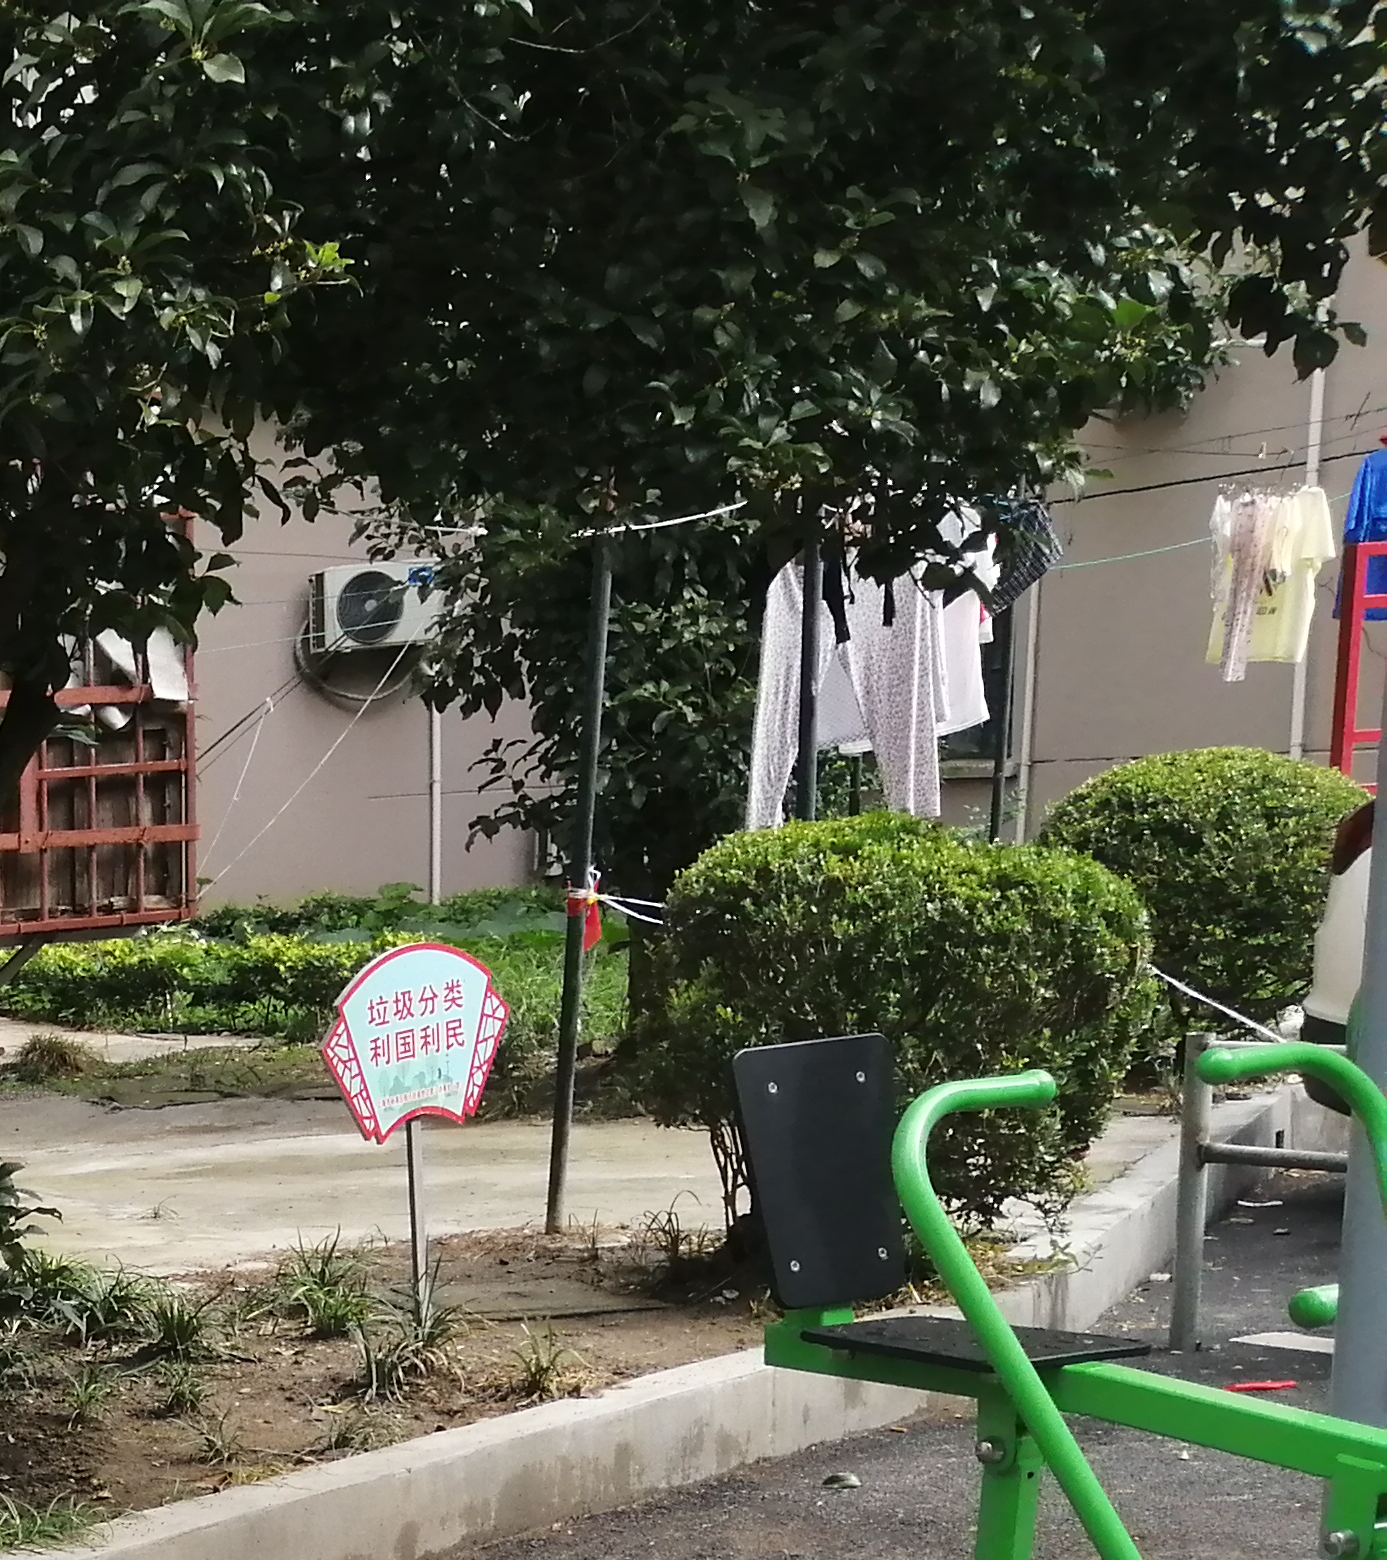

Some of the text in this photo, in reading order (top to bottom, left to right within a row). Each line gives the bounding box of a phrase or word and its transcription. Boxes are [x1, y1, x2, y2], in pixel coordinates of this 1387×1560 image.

[367, 979, 464, 1027] 垃圾分类
[369, 1018, 466, 1068] 利国利民
